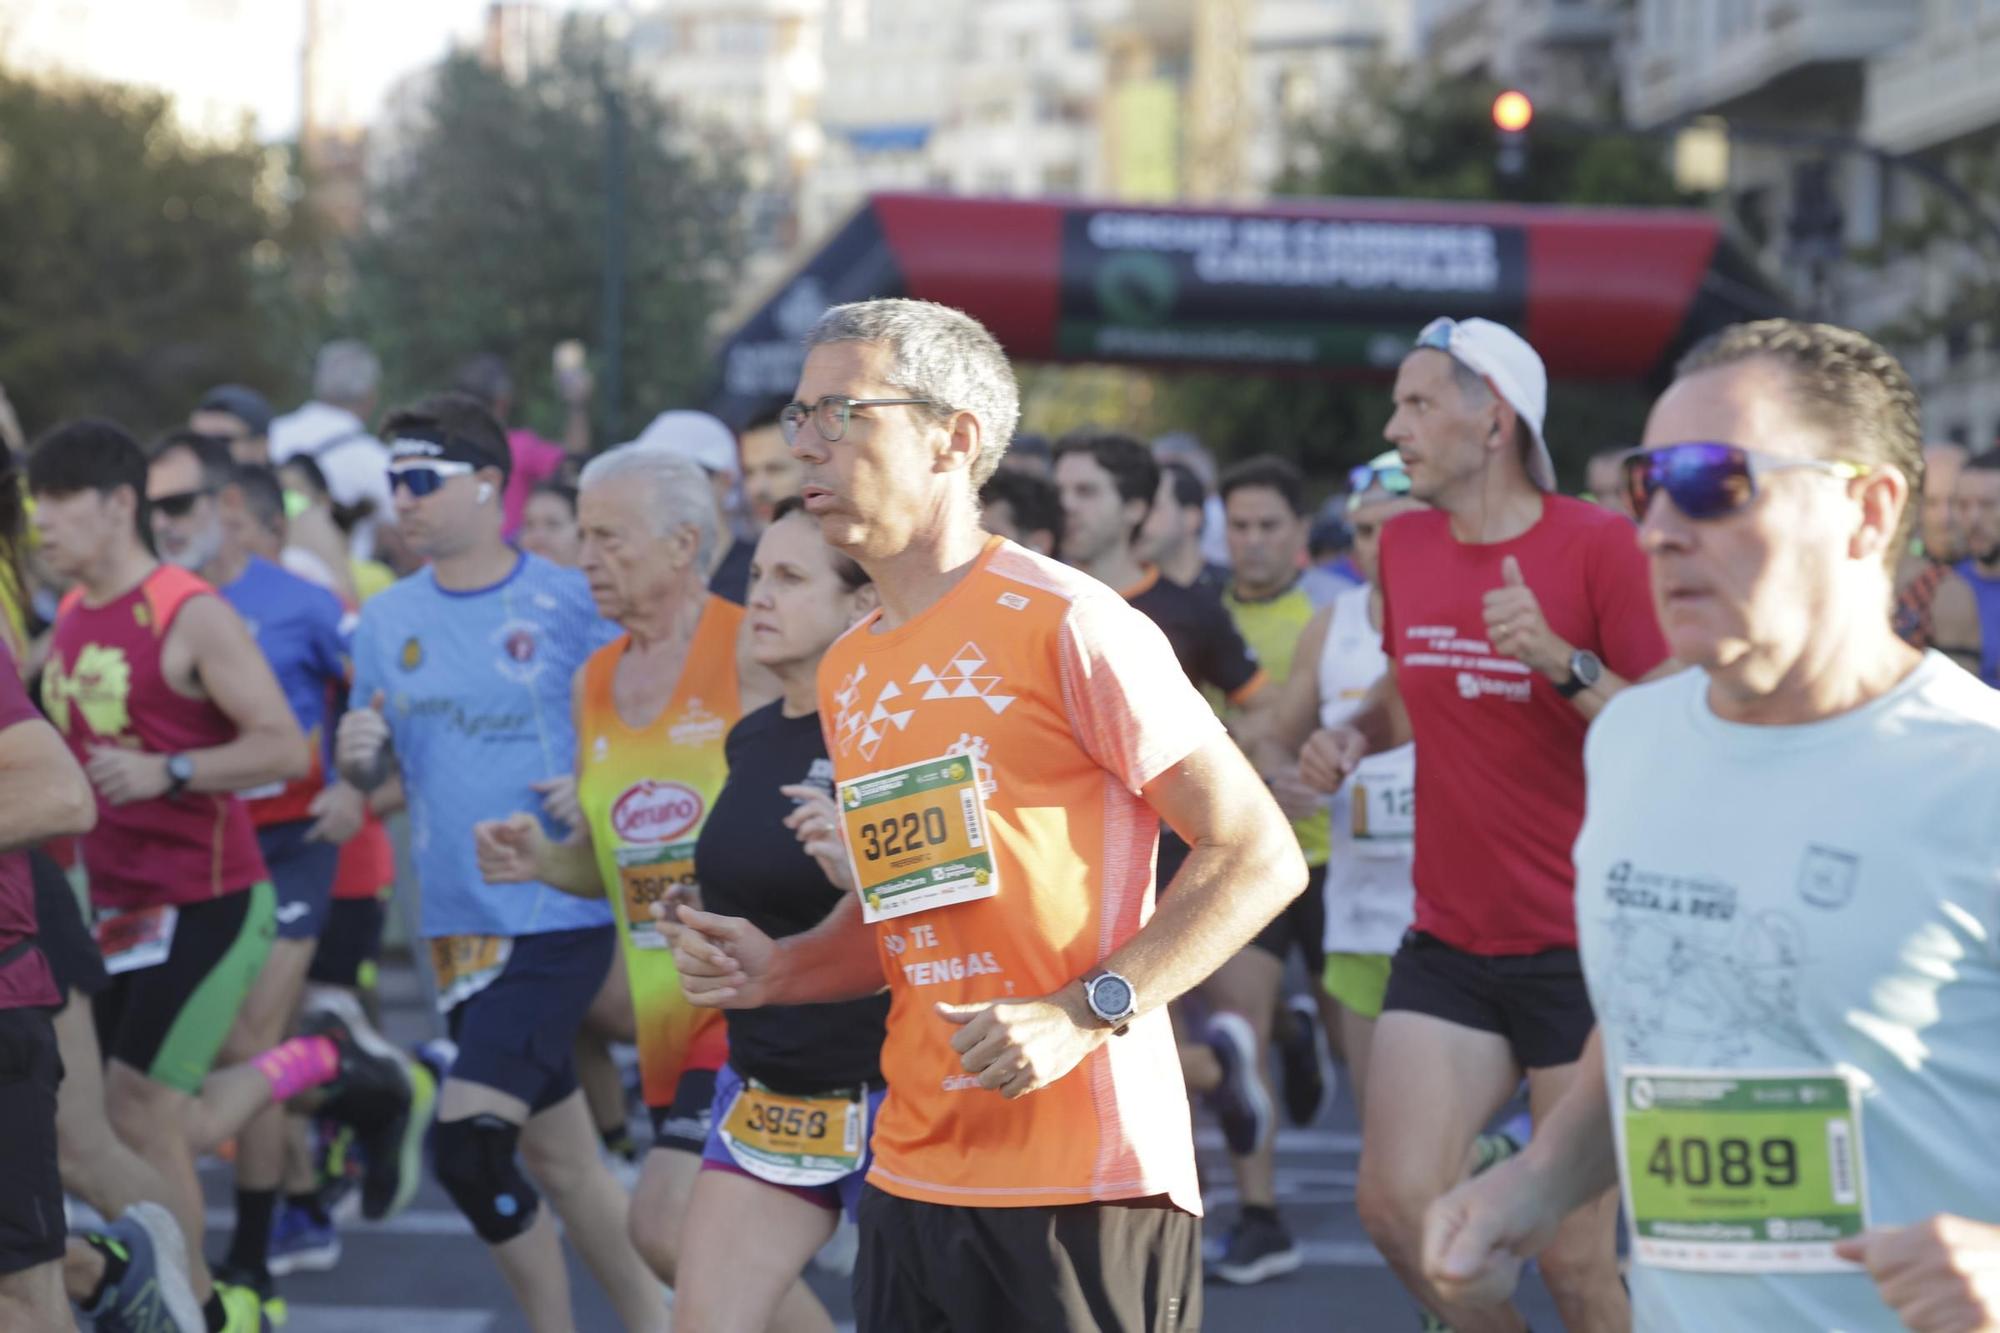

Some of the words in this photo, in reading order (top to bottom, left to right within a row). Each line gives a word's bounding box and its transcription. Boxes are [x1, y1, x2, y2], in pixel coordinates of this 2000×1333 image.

[1237, 217, 1288, 251] DE
[861, 807, 947, 861] 3220
[910, 924, 939, 949] TE
[747, 1104, 828, 1139] 3958
[1647, 1136, 1799, 1189] 4089
